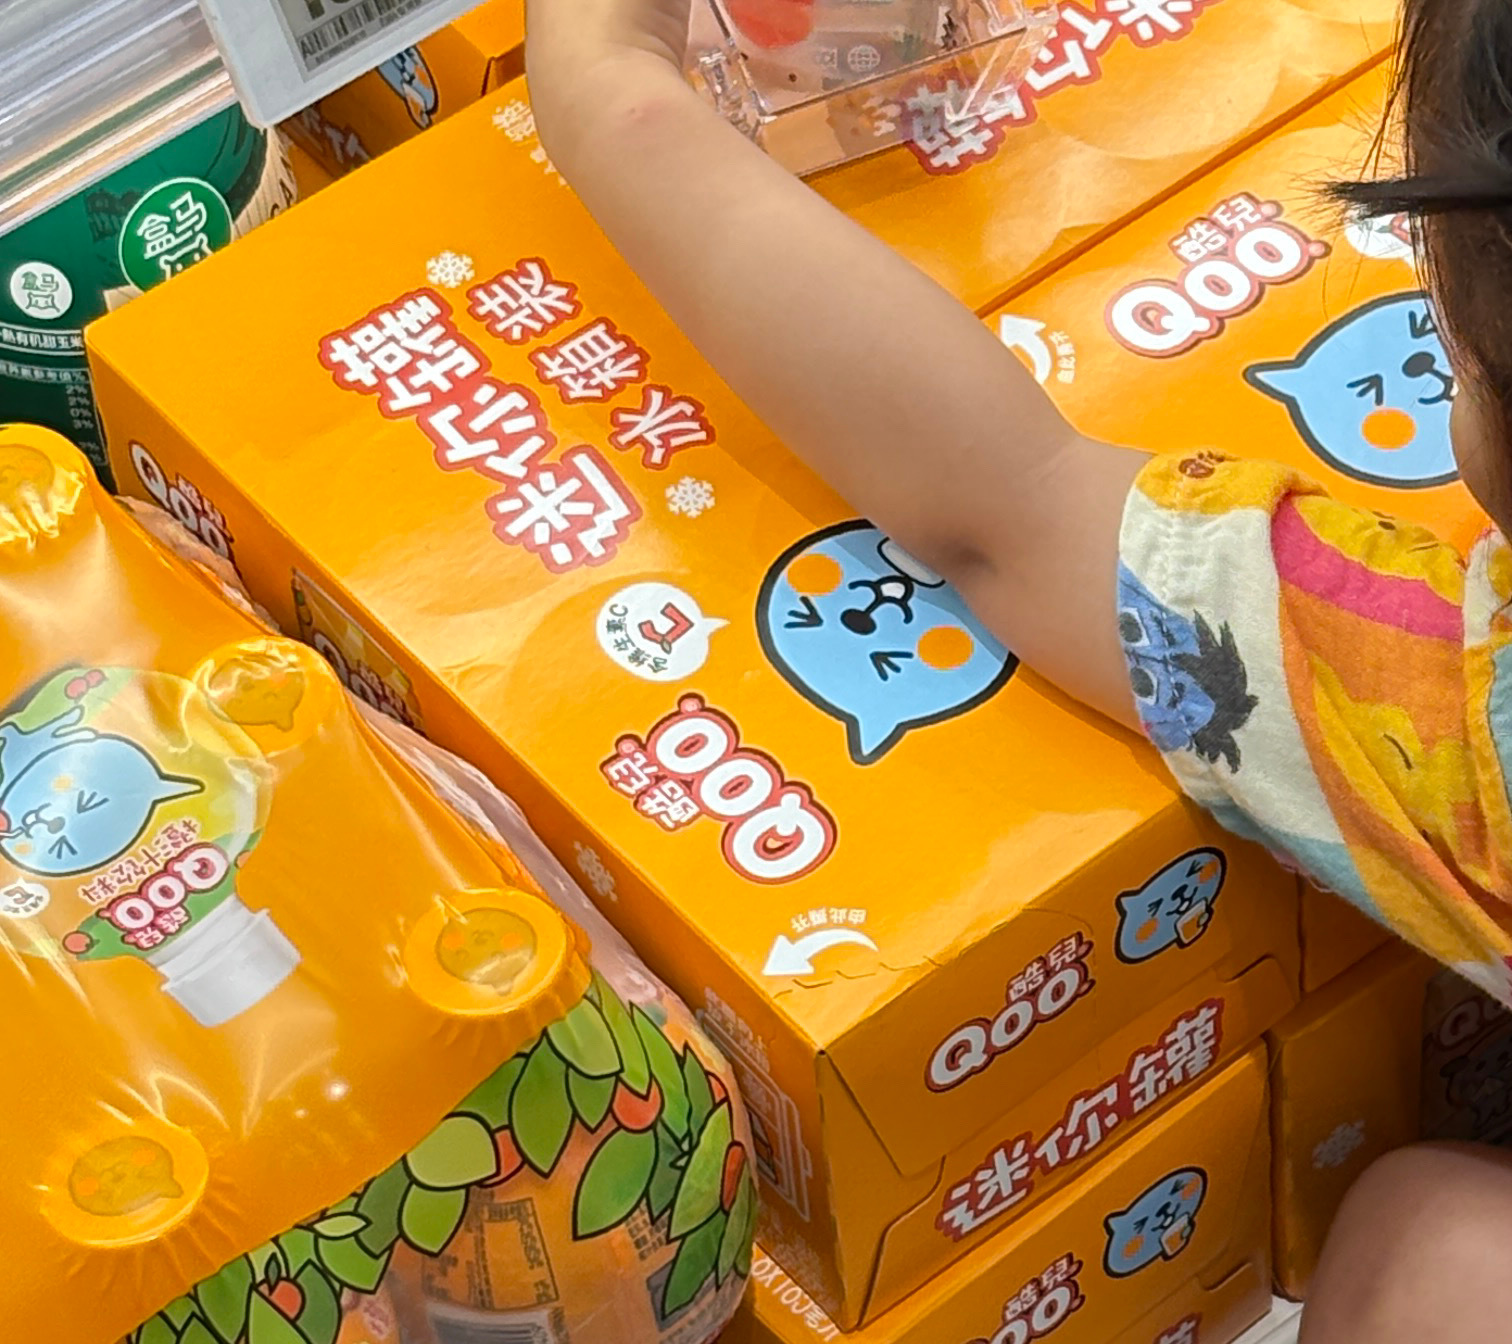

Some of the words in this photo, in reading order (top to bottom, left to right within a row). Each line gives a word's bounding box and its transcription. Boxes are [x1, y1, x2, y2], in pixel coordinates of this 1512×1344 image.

[22, 271, 60, 292] 盒马
[137, 191, 208, 260] 盒马
[330, 296, 630, 565] 迷你罐
[476, 261, 708, 464] 冰箱装
[942, 1002, 1218, 1234] 迷你罐
